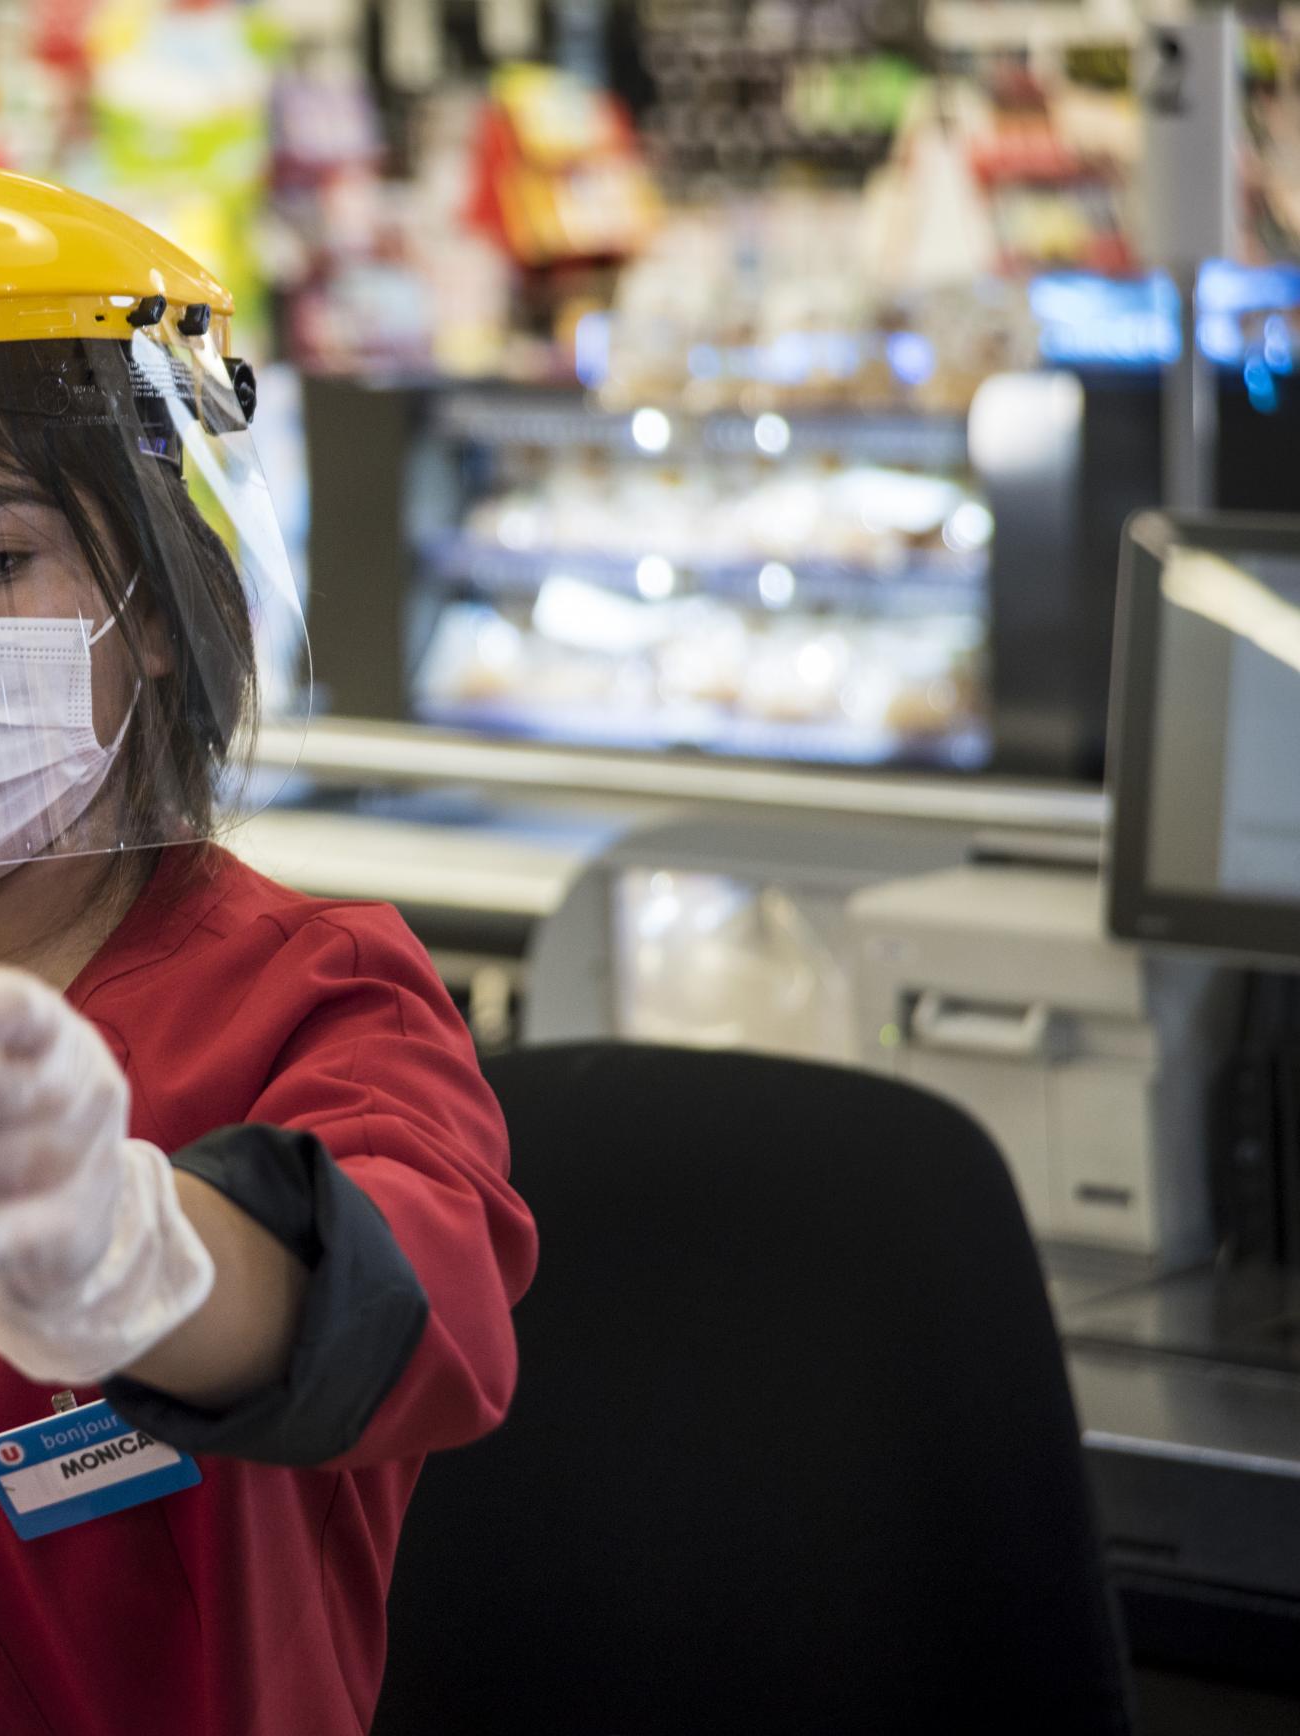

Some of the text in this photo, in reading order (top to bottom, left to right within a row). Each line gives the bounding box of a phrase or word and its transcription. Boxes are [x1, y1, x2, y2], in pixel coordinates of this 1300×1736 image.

[40, 1414, 118, 1449] bonjour
[0, 1445, 20, 1463] U
[60, 1431, 154, 1479] MONICA
